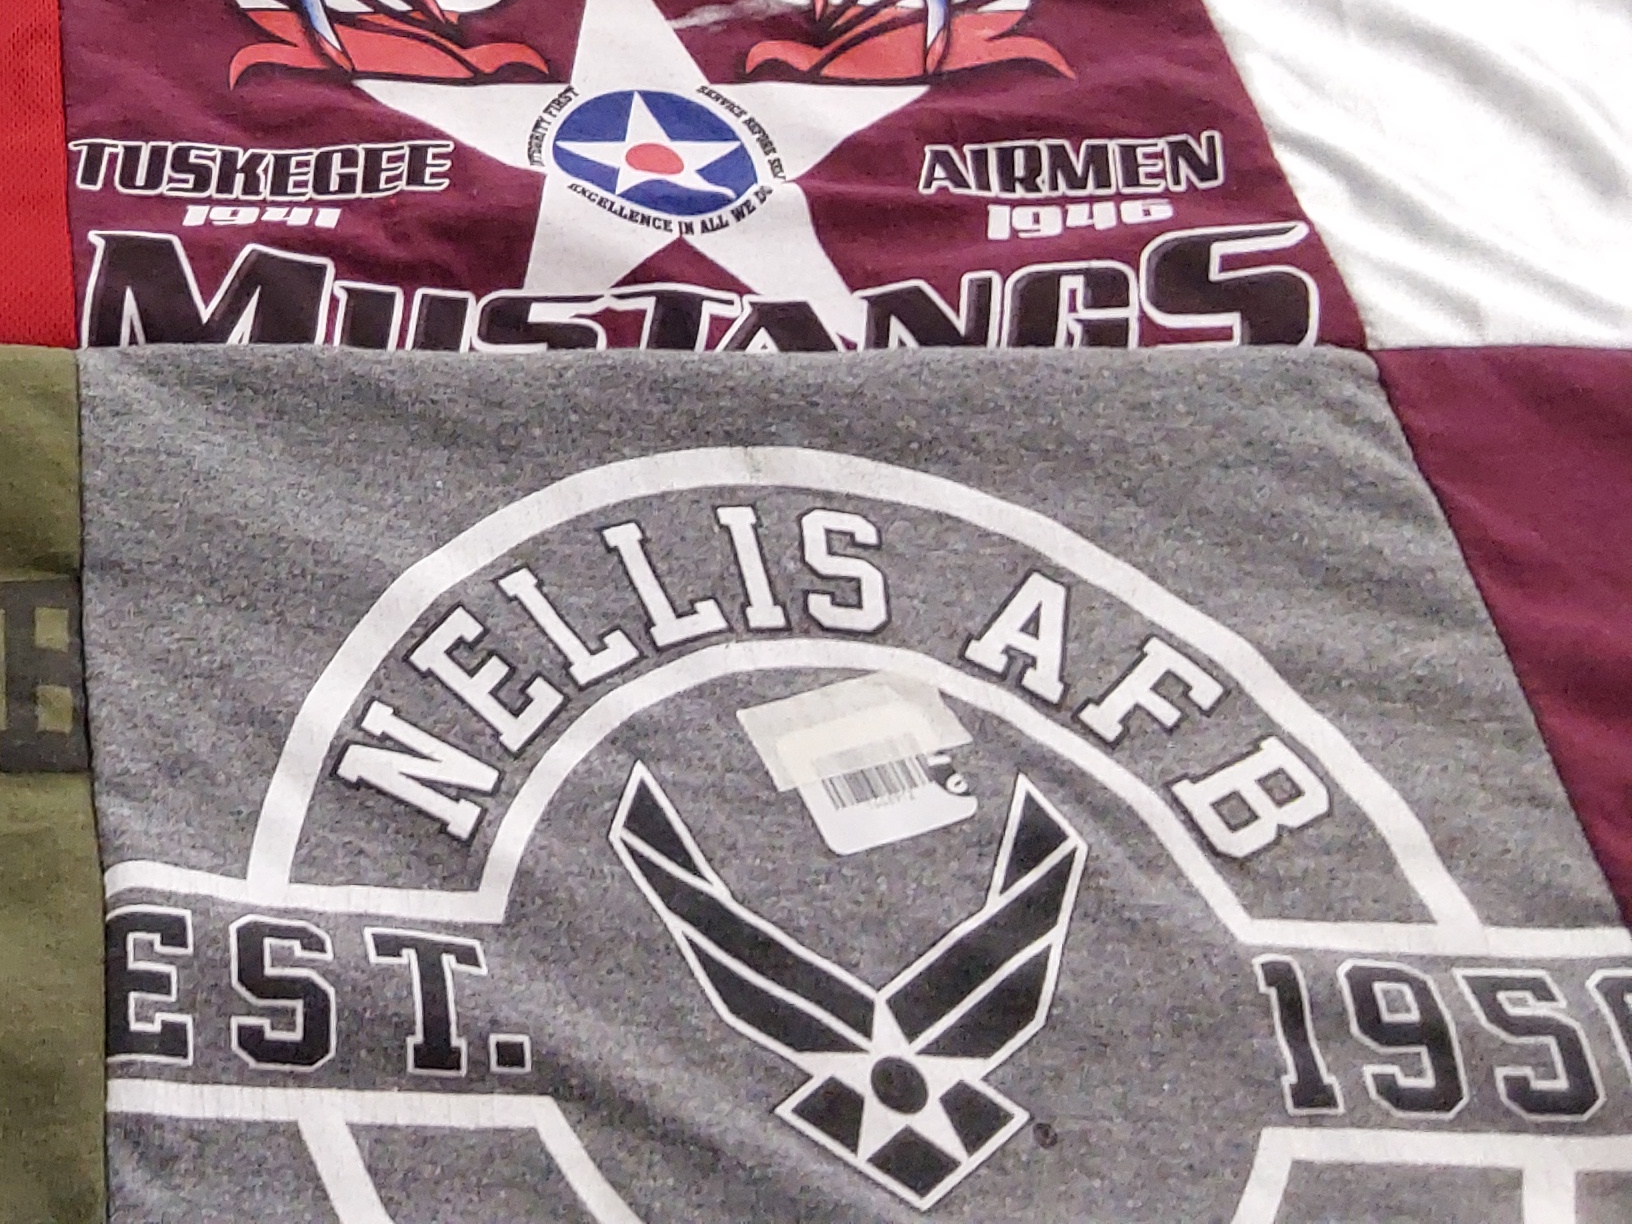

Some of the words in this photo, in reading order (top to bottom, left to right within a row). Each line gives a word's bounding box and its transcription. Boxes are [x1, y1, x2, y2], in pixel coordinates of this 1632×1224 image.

[542, 84, 580, 118] FIRST
[68, 139, 456, 200] TUSKEGEE
[918, 129, 1224, 199] AIRMEN
[181, 204, 342, 229] 1941
[568, 182, 673, 234] EXCELLENCE
[677, 220, 695, 236] IN
[700, 214, 730, 235] ALL
[731, 198, 757, 223] WE
[986, 198, 1174, 241] 1946
[81, 221, 1320, 352] MUSTANGS
[333, 504, 893, 842] NELLIS
[965, 571, 1332, 862] AFB
[105, 903, 533, 1077] EST.
